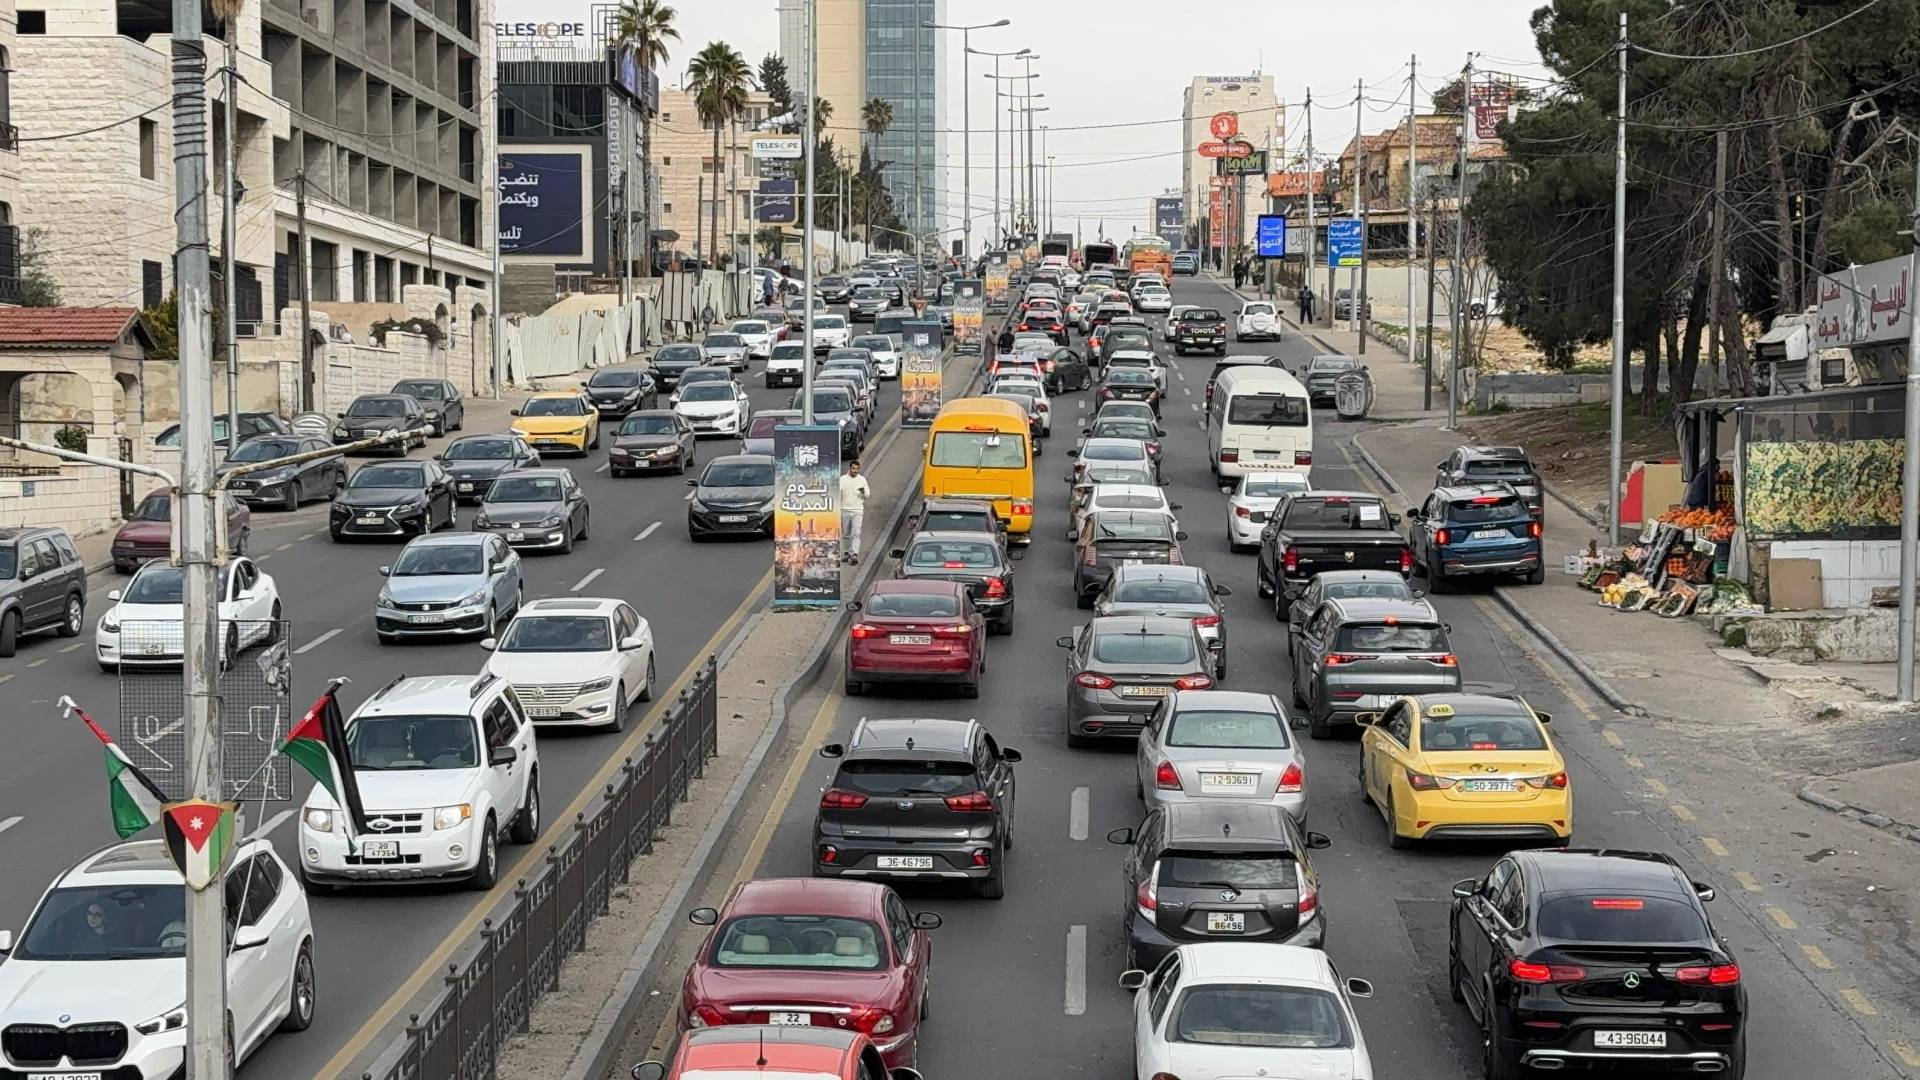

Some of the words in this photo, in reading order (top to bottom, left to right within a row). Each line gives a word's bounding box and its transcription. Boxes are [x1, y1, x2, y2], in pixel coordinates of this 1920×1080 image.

[496, 22, 584, 39] ELESCOPE
[1191, 327, 1216, 335] TOYOTA
[787, 483, 827, 497] يوم
[781, 497, 832, 515] المدينة
[787, 1013, 800, 1023] 22
[1607, 1032, 1664, 1045] 43-96044
